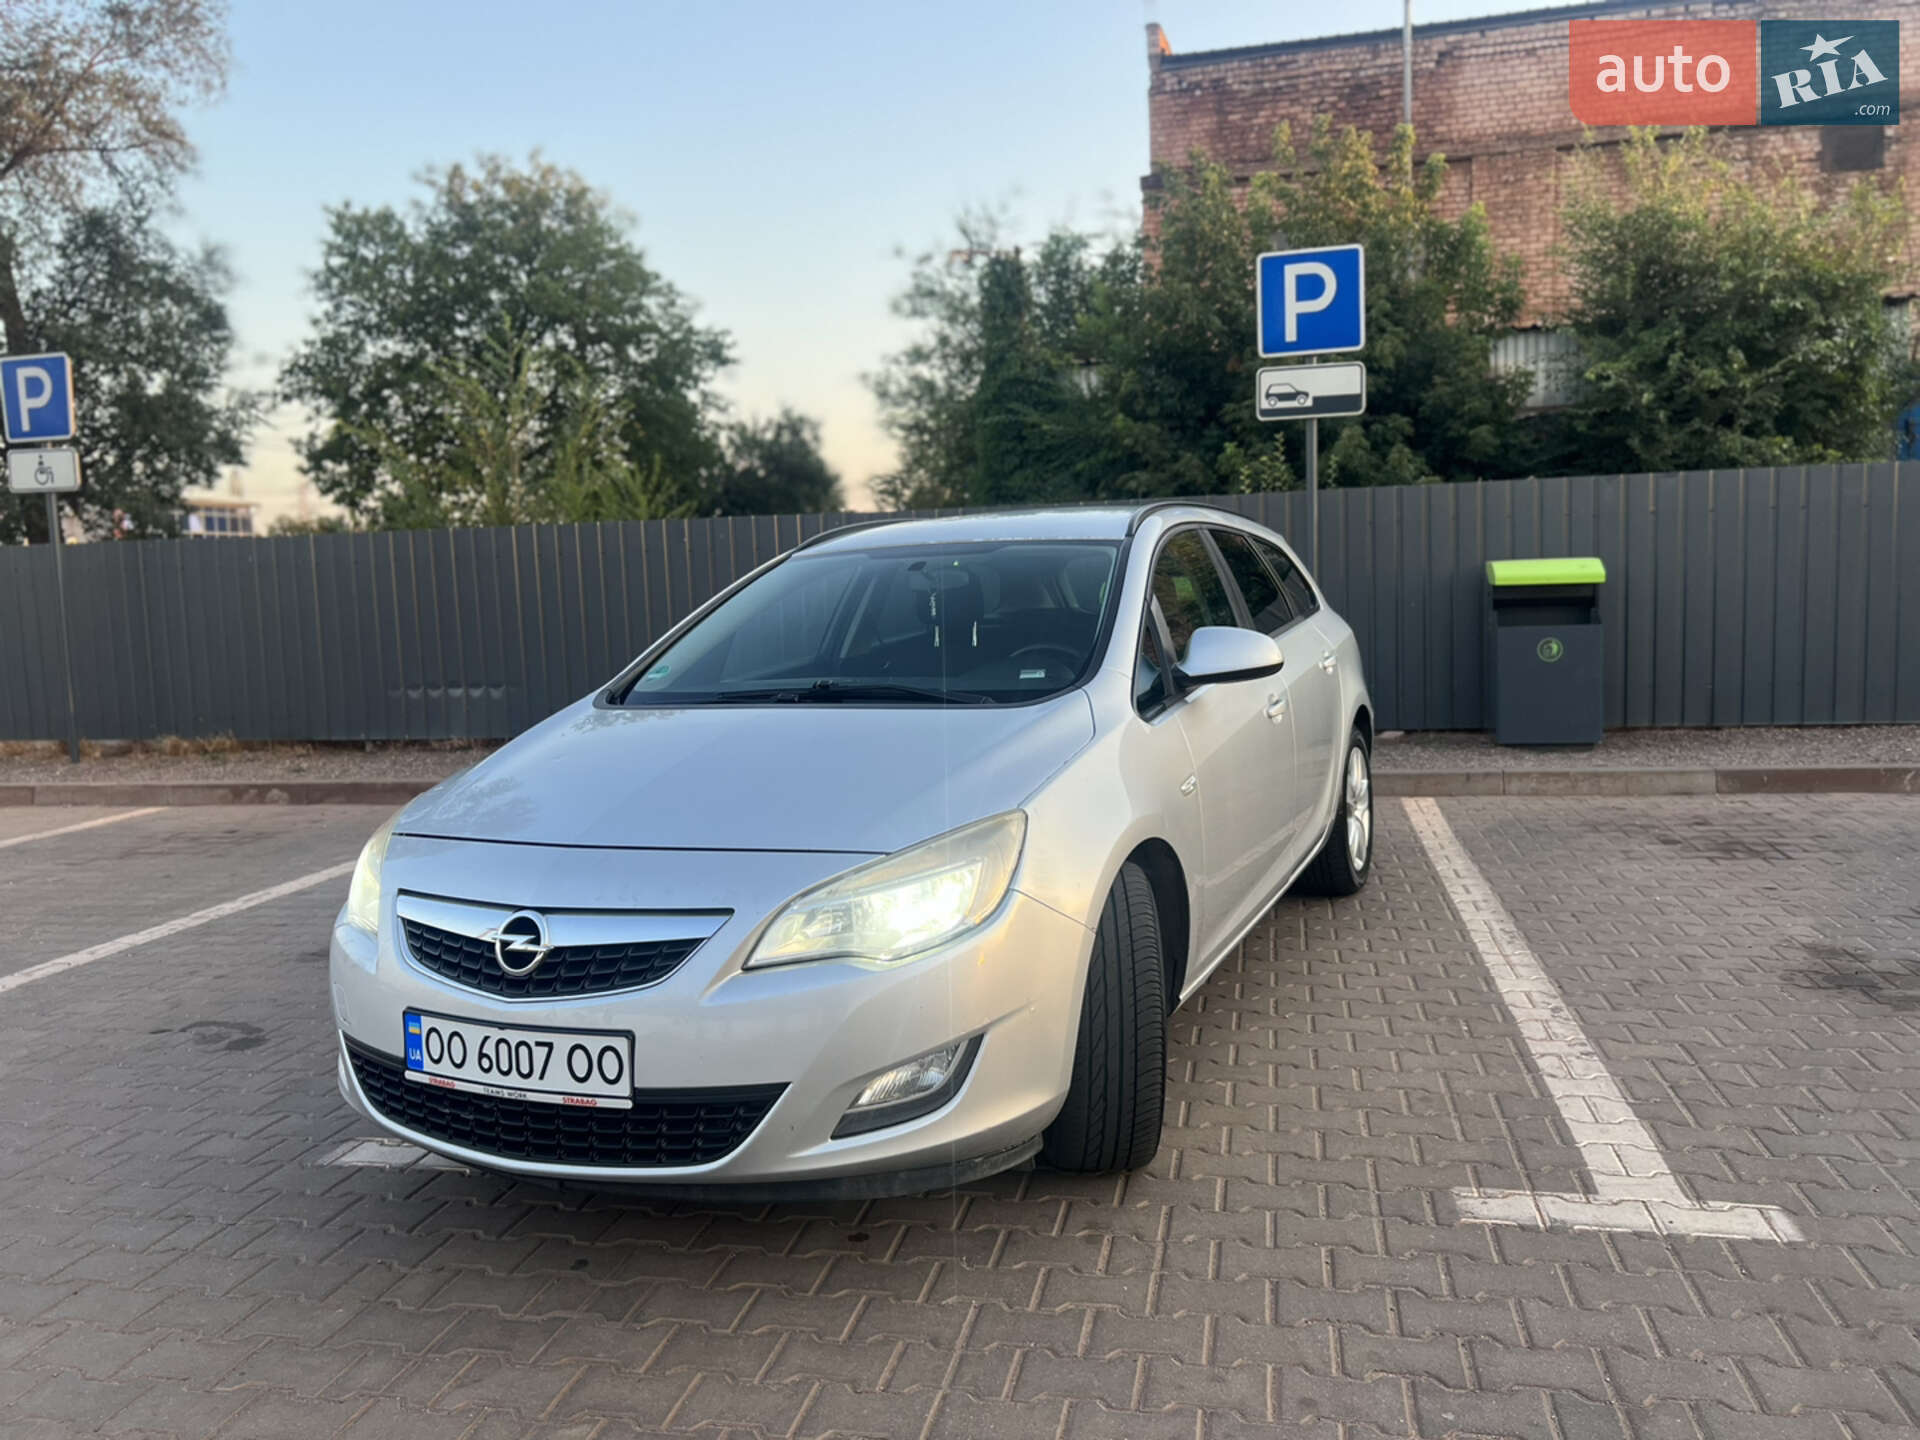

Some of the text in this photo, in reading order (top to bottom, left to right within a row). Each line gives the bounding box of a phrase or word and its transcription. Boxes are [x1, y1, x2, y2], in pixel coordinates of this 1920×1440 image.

[1284, 262, 1337, 343] P
[16, 366, 53, 432] P
[409, 1047, 422, 1061] UA
[477, 1035, 554, 1081] 6007
[428, 1076, 456, 1089] STRABAG
[562, 1096, 598, 1106] STRABAG
